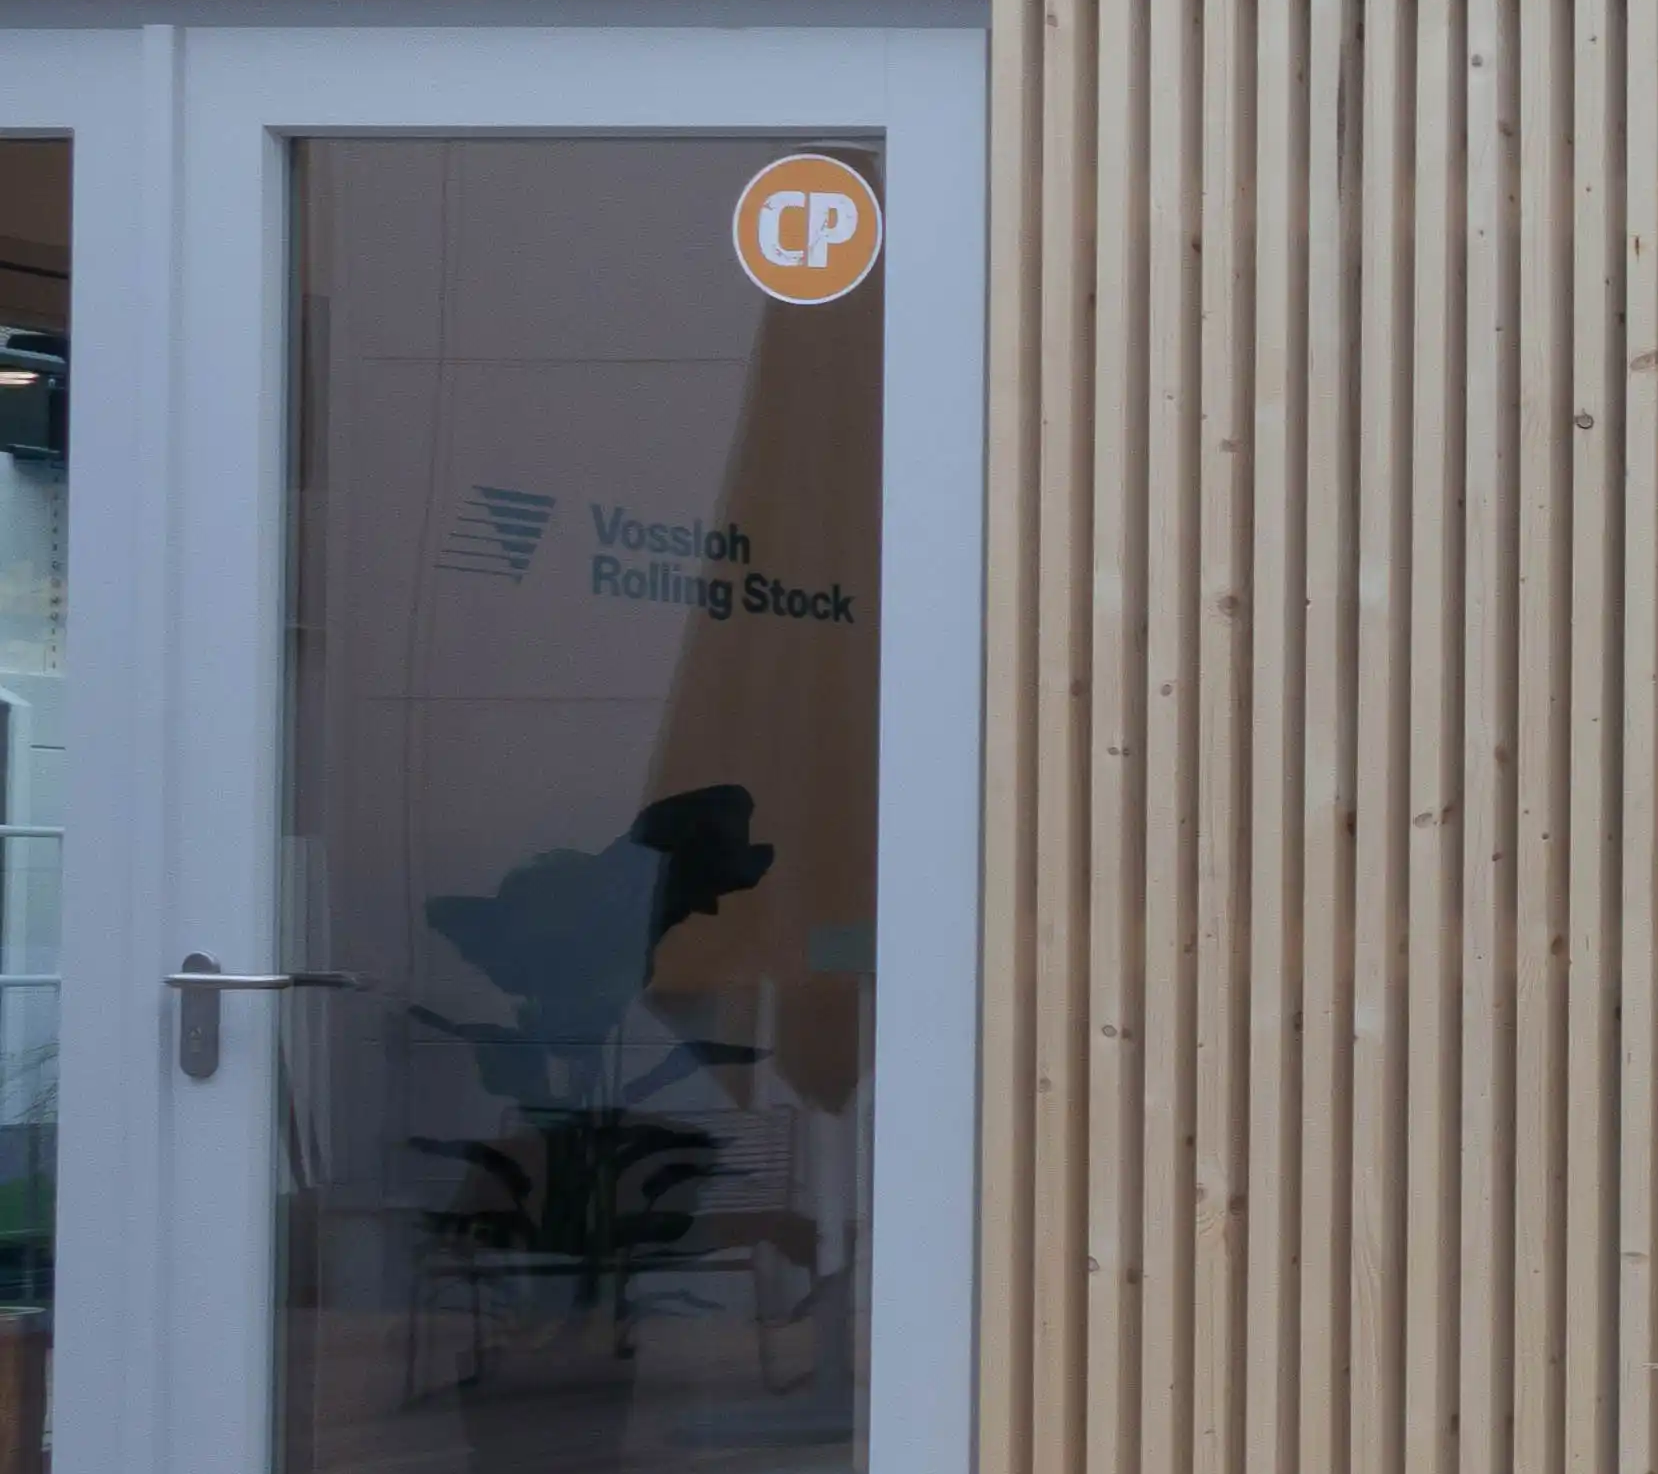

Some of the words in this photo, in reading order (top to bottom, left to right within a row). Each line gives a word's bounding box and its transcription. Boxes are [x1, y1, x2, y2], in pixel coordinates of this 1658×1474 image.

[757, 190, 859, 268] CP
[590, 502, 751, 565] Vossloh
[591, 553, 733, 621] Rolling
[742, 571, 856, 624] Stock
